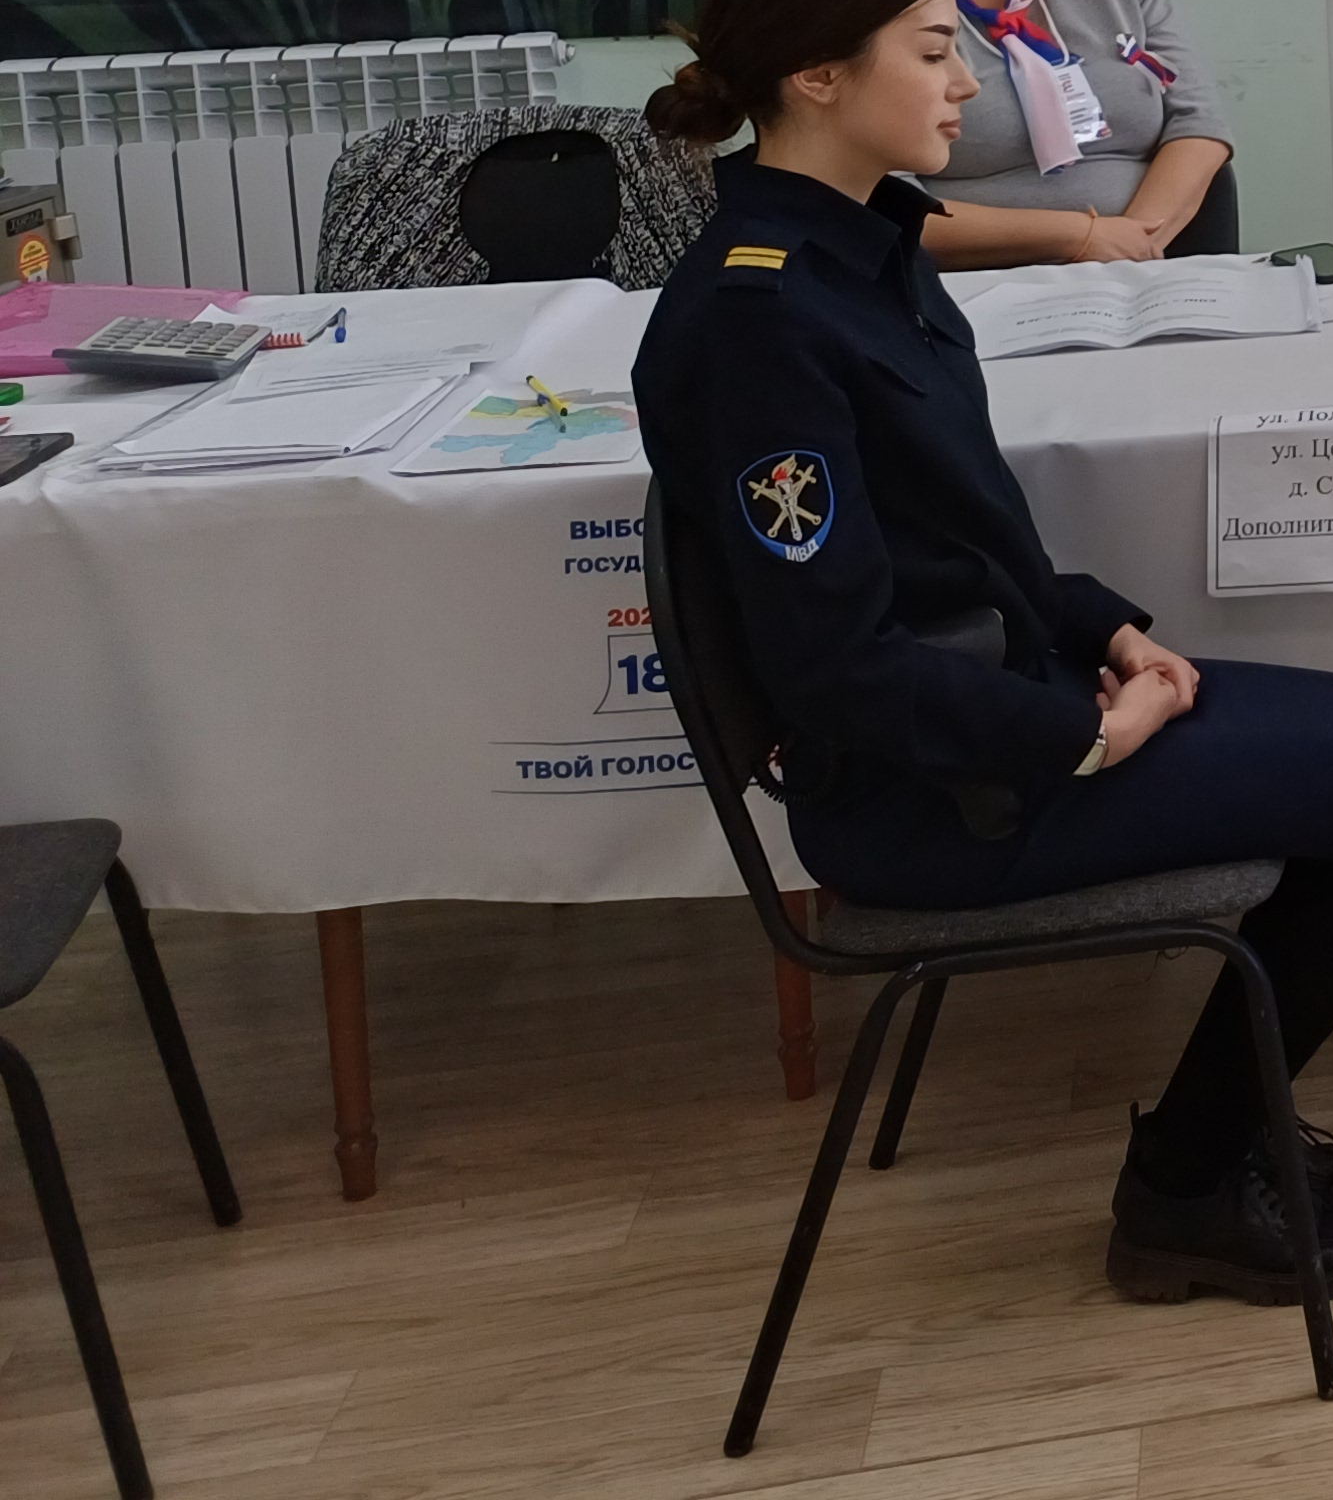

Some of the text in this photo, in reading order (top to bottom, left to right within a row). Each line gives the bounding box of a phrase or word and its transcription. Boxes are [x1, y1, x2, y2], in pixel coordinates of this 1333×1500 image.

[1256, 412, 1288, 429] ул.
[1271, 444, 1304, 464] ул.
[1288, 481, 1308, 499] д.
[570, 518, 645, 540] ВЫБО
[785, 538, 819, 562] МВД
[564, 555, 645, 574] ГОСУД
[607, 608, 653, 628] 202
[617, 652, 670, 695] 18
[516, 752, 695, 780] ТВОЙ ГОЛОС
